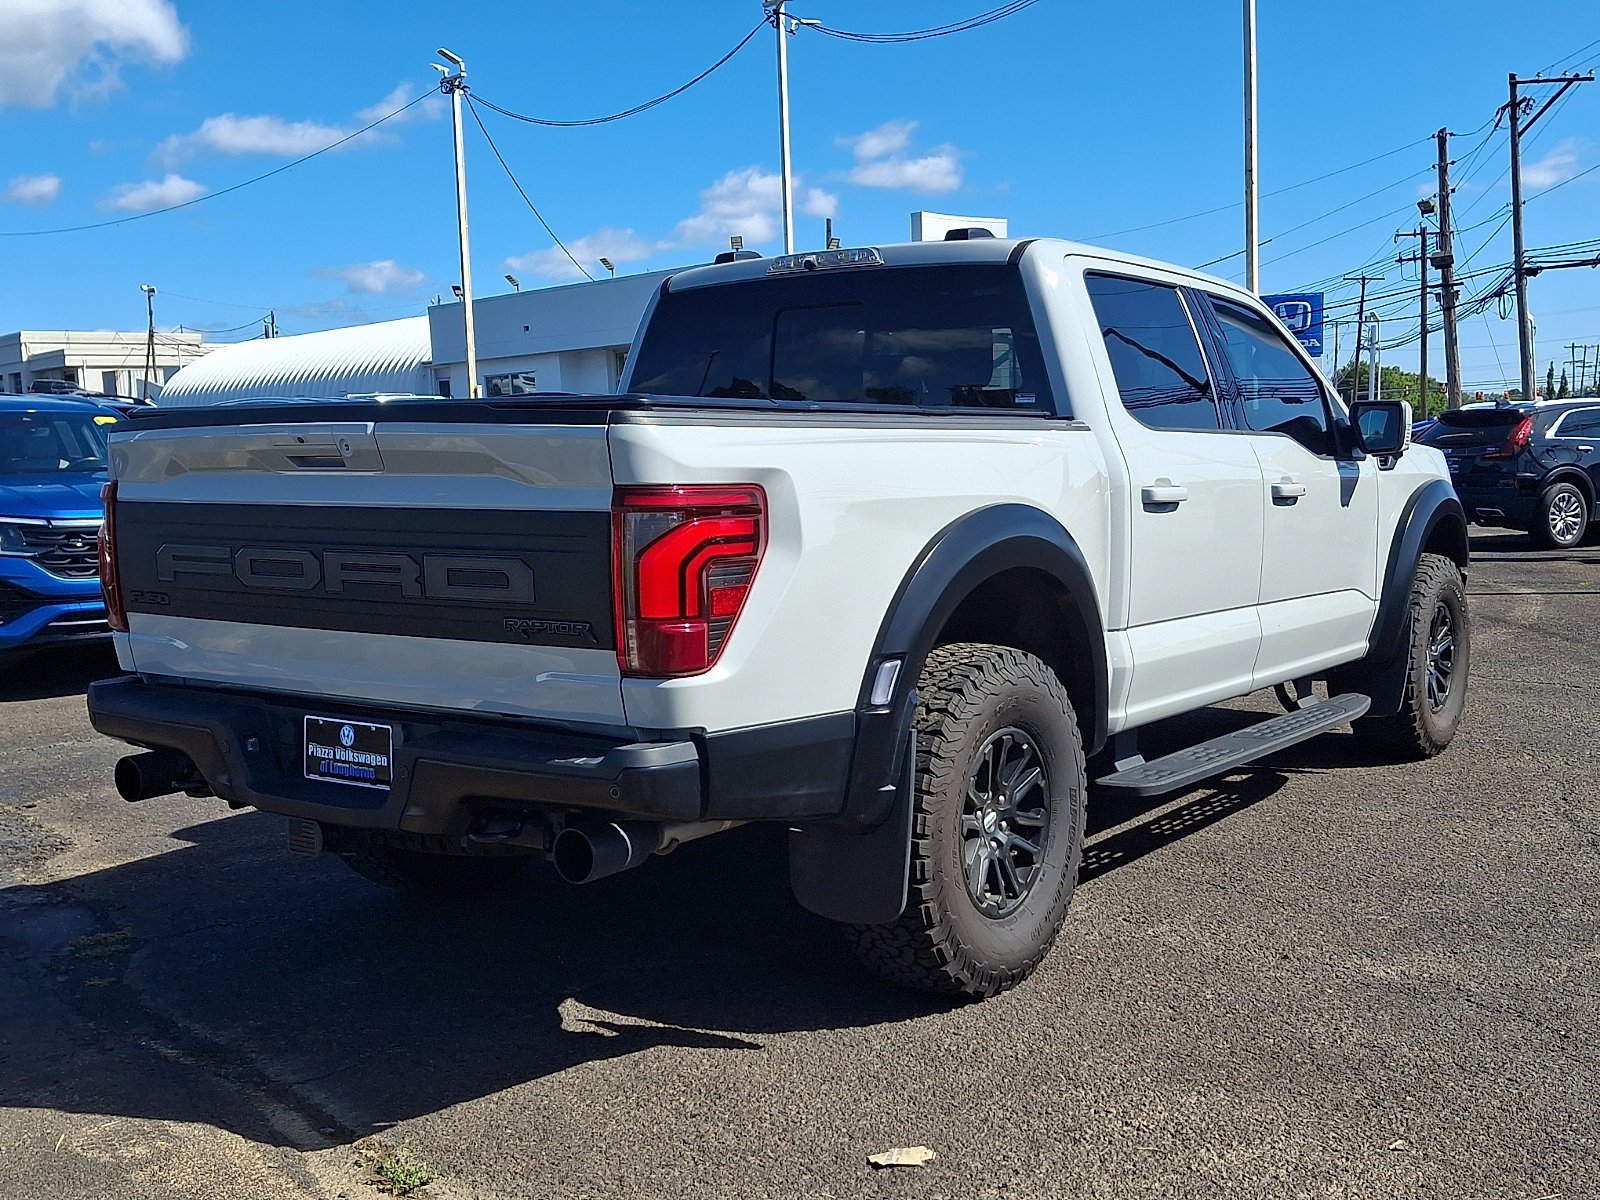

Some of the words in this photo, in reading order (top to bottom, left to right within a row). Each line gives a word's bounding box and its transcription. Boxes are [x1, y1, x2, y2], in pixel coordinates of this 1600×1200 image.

[156, 542, 536, 603] FORD
[503, 617, 598, 644] RAPTOR
[308, 743, 334, 759] Piazza
[335, 746, 388, 766] Volkswagen
[320, 760, 330, 773] of
